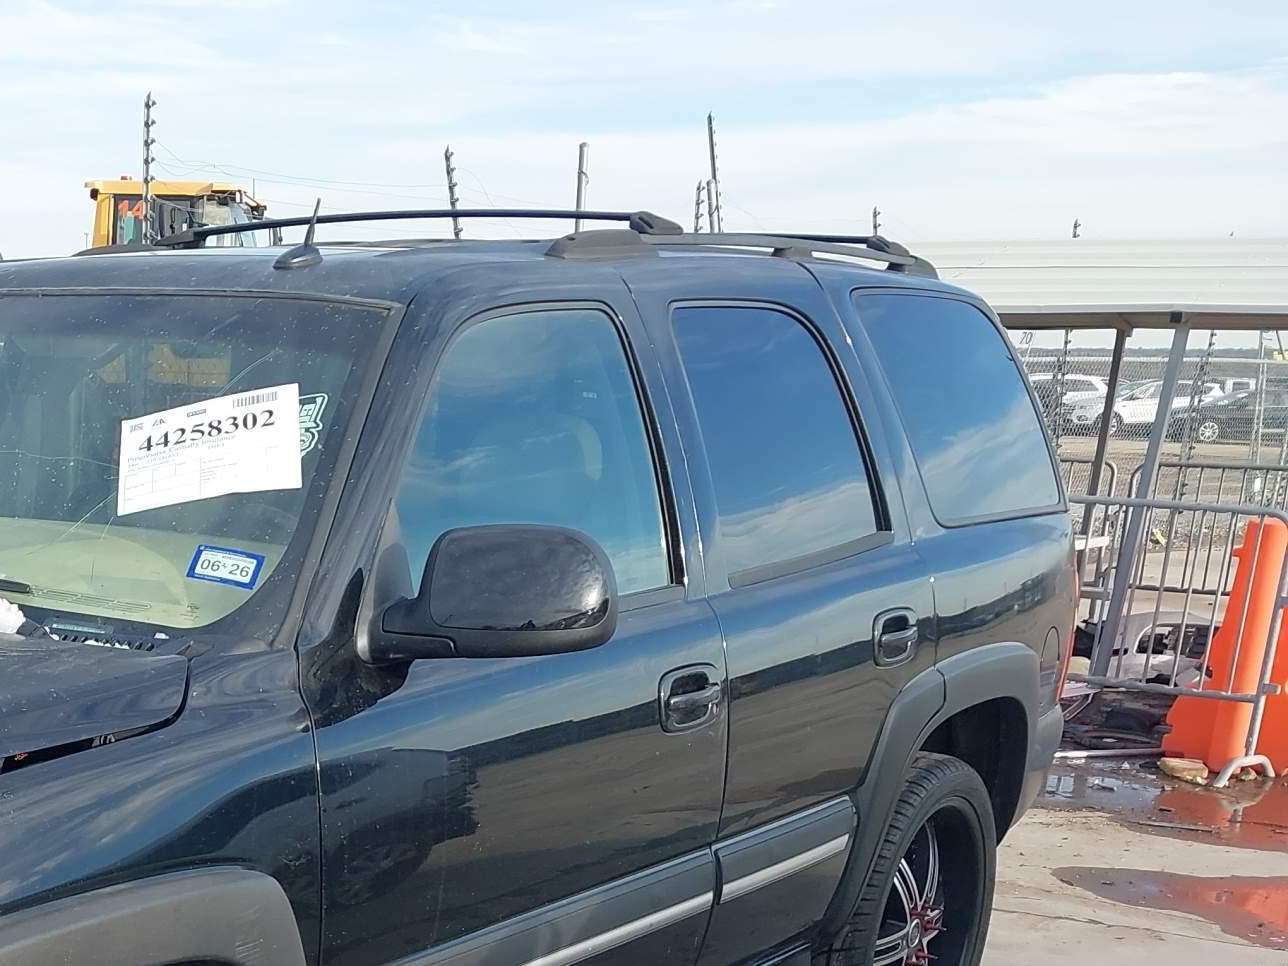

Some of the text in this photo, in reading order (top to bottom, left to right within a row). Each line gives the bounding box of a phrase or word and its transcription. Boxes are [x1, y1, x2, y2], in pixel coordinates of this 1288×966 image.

[138, 409, 276, 452] 44258302
[200, 558, 222, 572] 06
[228, 563, 251, 578] 26
